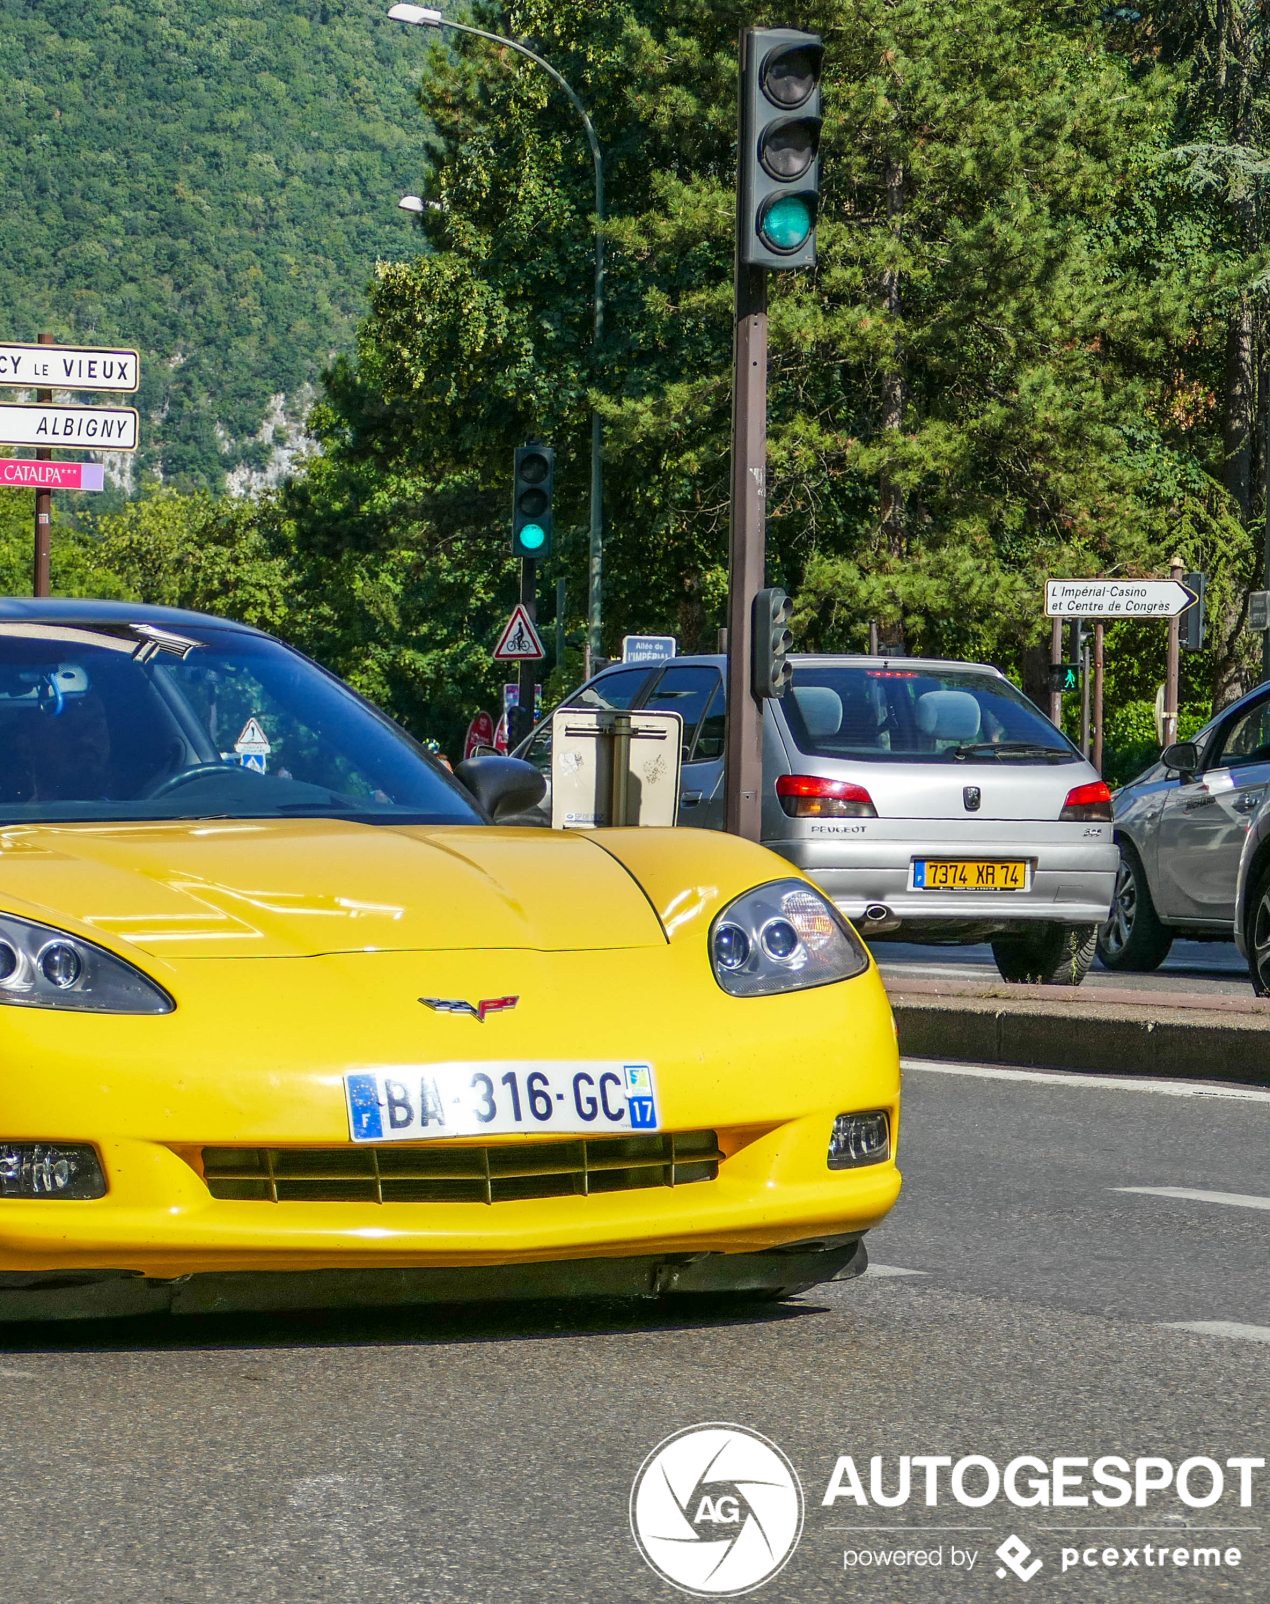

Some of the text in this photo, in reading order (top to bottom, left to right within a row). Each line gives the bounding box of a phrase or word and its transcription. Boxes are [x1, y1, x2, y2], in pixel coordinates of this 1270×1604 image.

[34, 363, 49, 376] LE
[62, 358, 129, 381] VIEUX
[36, 416, 128, 439] ALBIGNY
[4, 464, 62, 483] CATALPA
[1051, 585, 1147, 600] L'Impérial-Casino
[1051, 600, 1170, 614] et Centre de Congrès
[636, 642, 653, 650] Allée
[811, 825, 867, 834] PEUGEOT
[928, 864, 968, 885] 7374
[976, 864, 995, 885] XR
[1001, 864, 1019, 885] 74
[361, 1070, 652, 1130] F BA-316-GC 17
